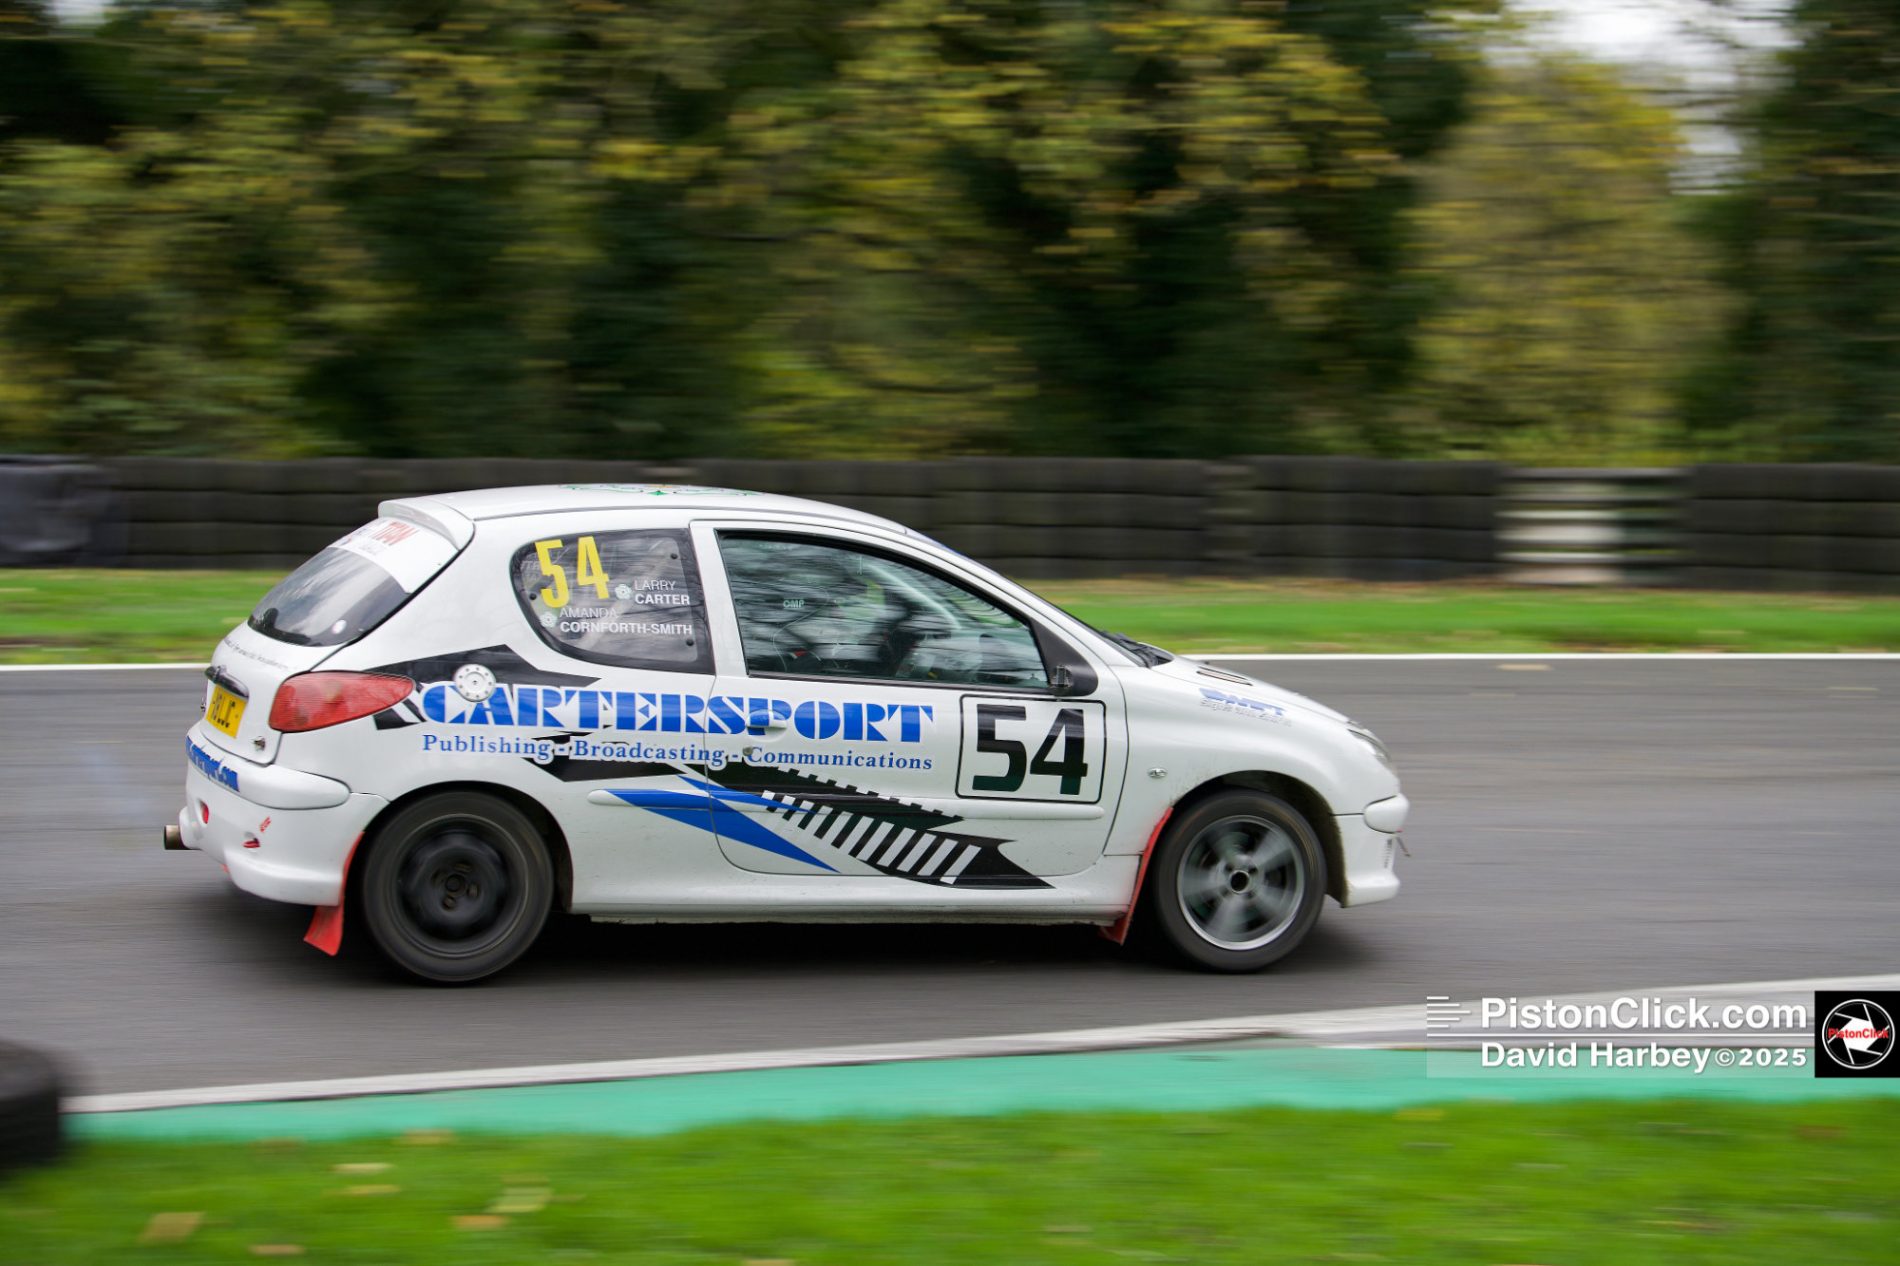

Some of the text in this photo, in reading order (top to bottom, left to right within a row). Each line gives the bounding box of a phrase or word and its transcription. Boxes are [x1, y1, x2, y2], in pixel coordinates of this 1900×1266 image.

[535, 536, 609, 608] 54
[634, 580, 676, 591] LARRY
[634, 593, 691, 605] CARTER
[560, 607, 618, 618] AMANDA
[560, 621, 693, 635] CORNFORTH-SMITH
[422, 685, 934, 743] CARTERSPORT
[423, 734, 551, 761] Publishing
[574, 740, 725, 767] Broadcasting
[747, 746, 933, 770] Communications
[972, 703, 1088, 796] 54
